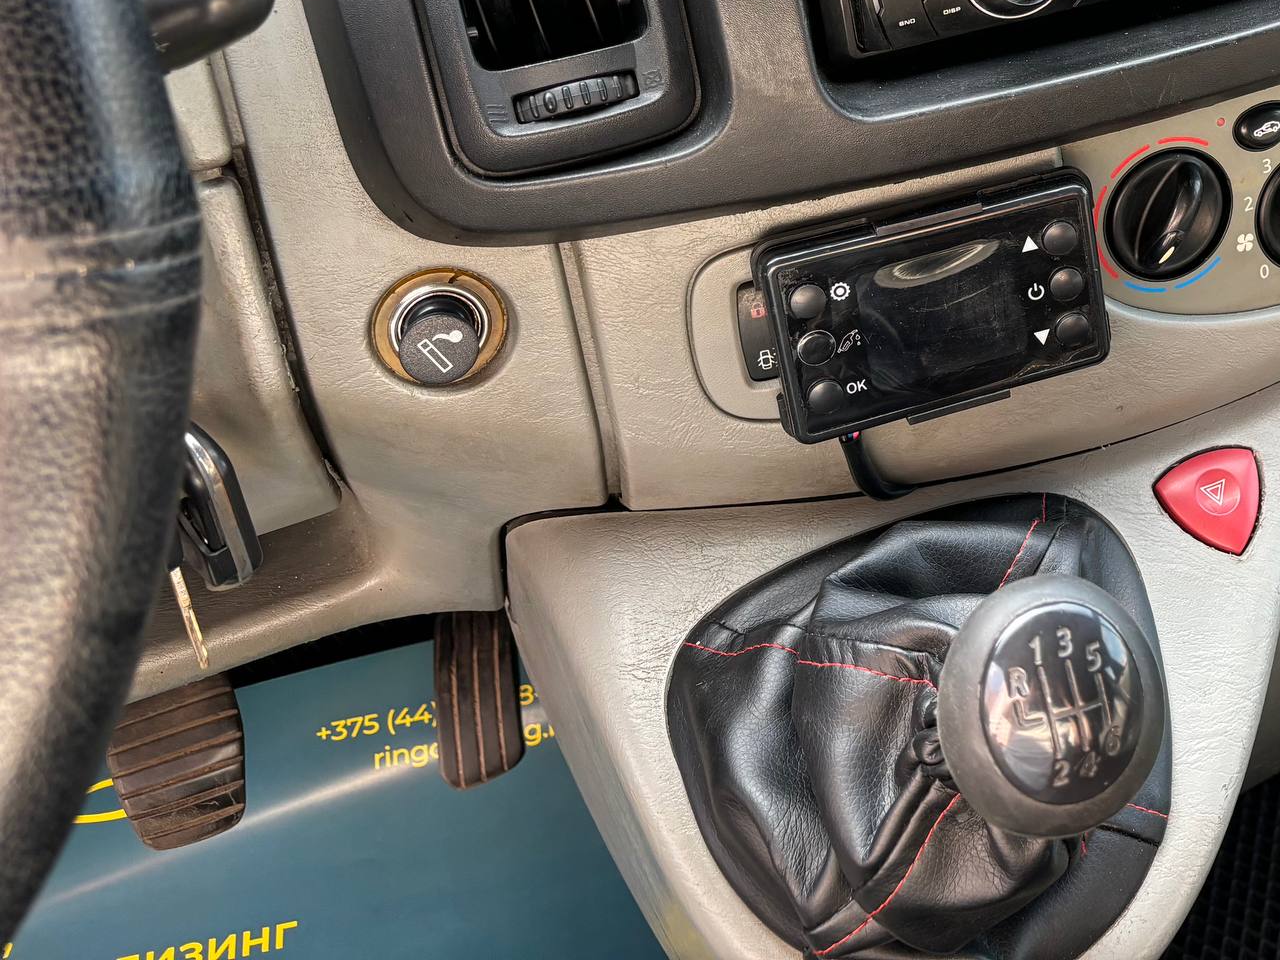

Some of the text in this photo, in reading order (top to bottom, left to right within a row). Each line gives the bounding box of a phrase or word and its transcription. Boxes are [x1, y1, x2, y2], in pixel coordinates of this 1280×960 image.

[942, 6, 961, 16] DISP
[1261, 158, 1273, 174] 3
[1243, 196, 1254, 213] 2
[846, 378, 868, 395] OK
[1028, 635, 1043, 666] 1
[1055, 626, 1074, 658] 3
[1085, 640, 1102, 673] 5
[1007, 666, 1030, 699] R
[315, 712, 381, 742] +375
[1052, 760, 1071, 788] 2
